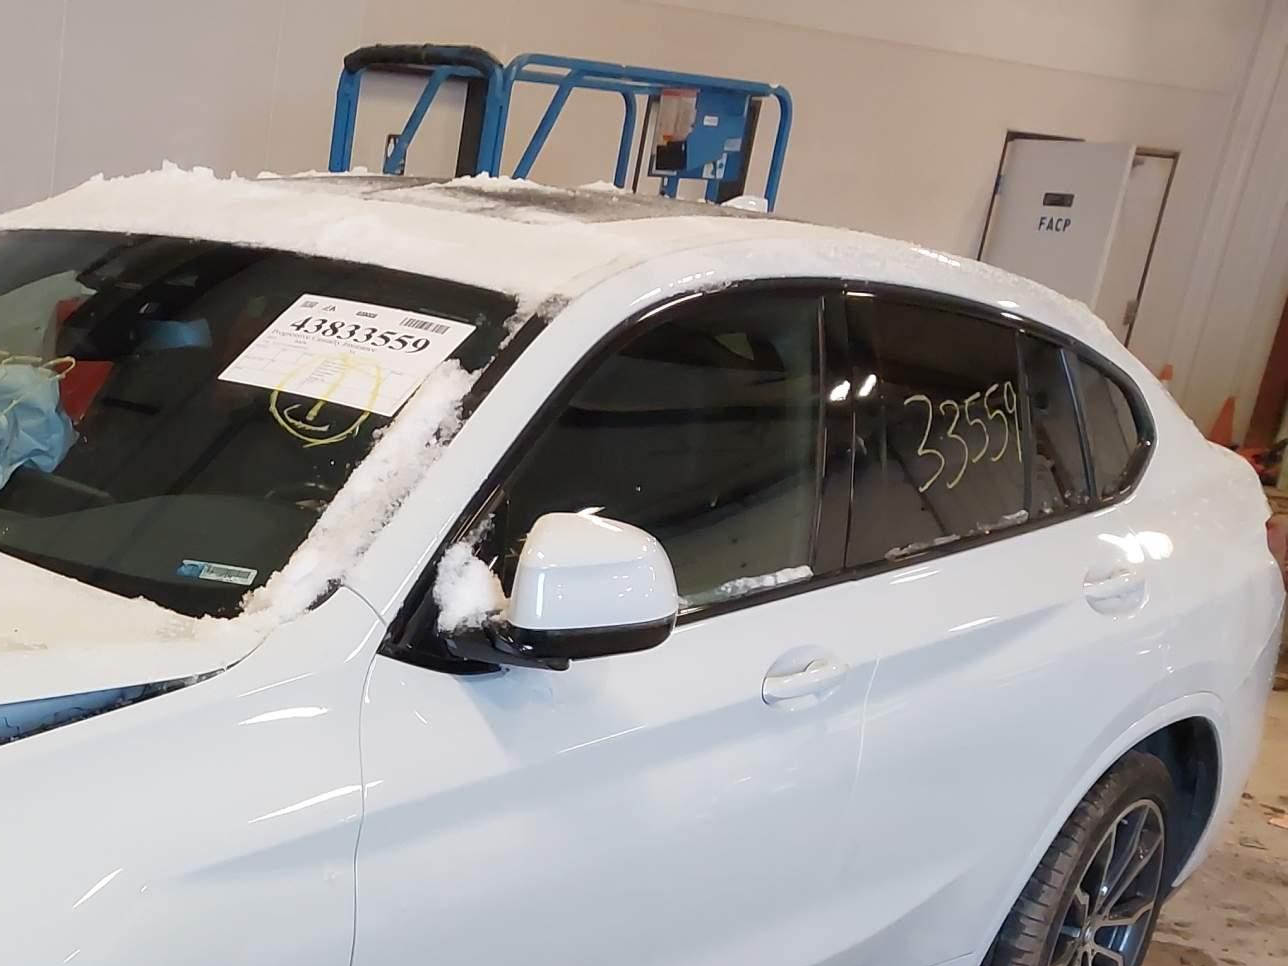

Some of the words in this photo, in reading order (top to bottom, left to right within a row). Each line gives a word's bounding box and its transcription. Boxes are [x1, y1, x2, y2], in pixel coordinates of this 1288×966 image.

[1038, 216, 1072, 232] FACP
[290, 316, 430, 354] 43833559
[903, 381, 1022, 492] 33559
